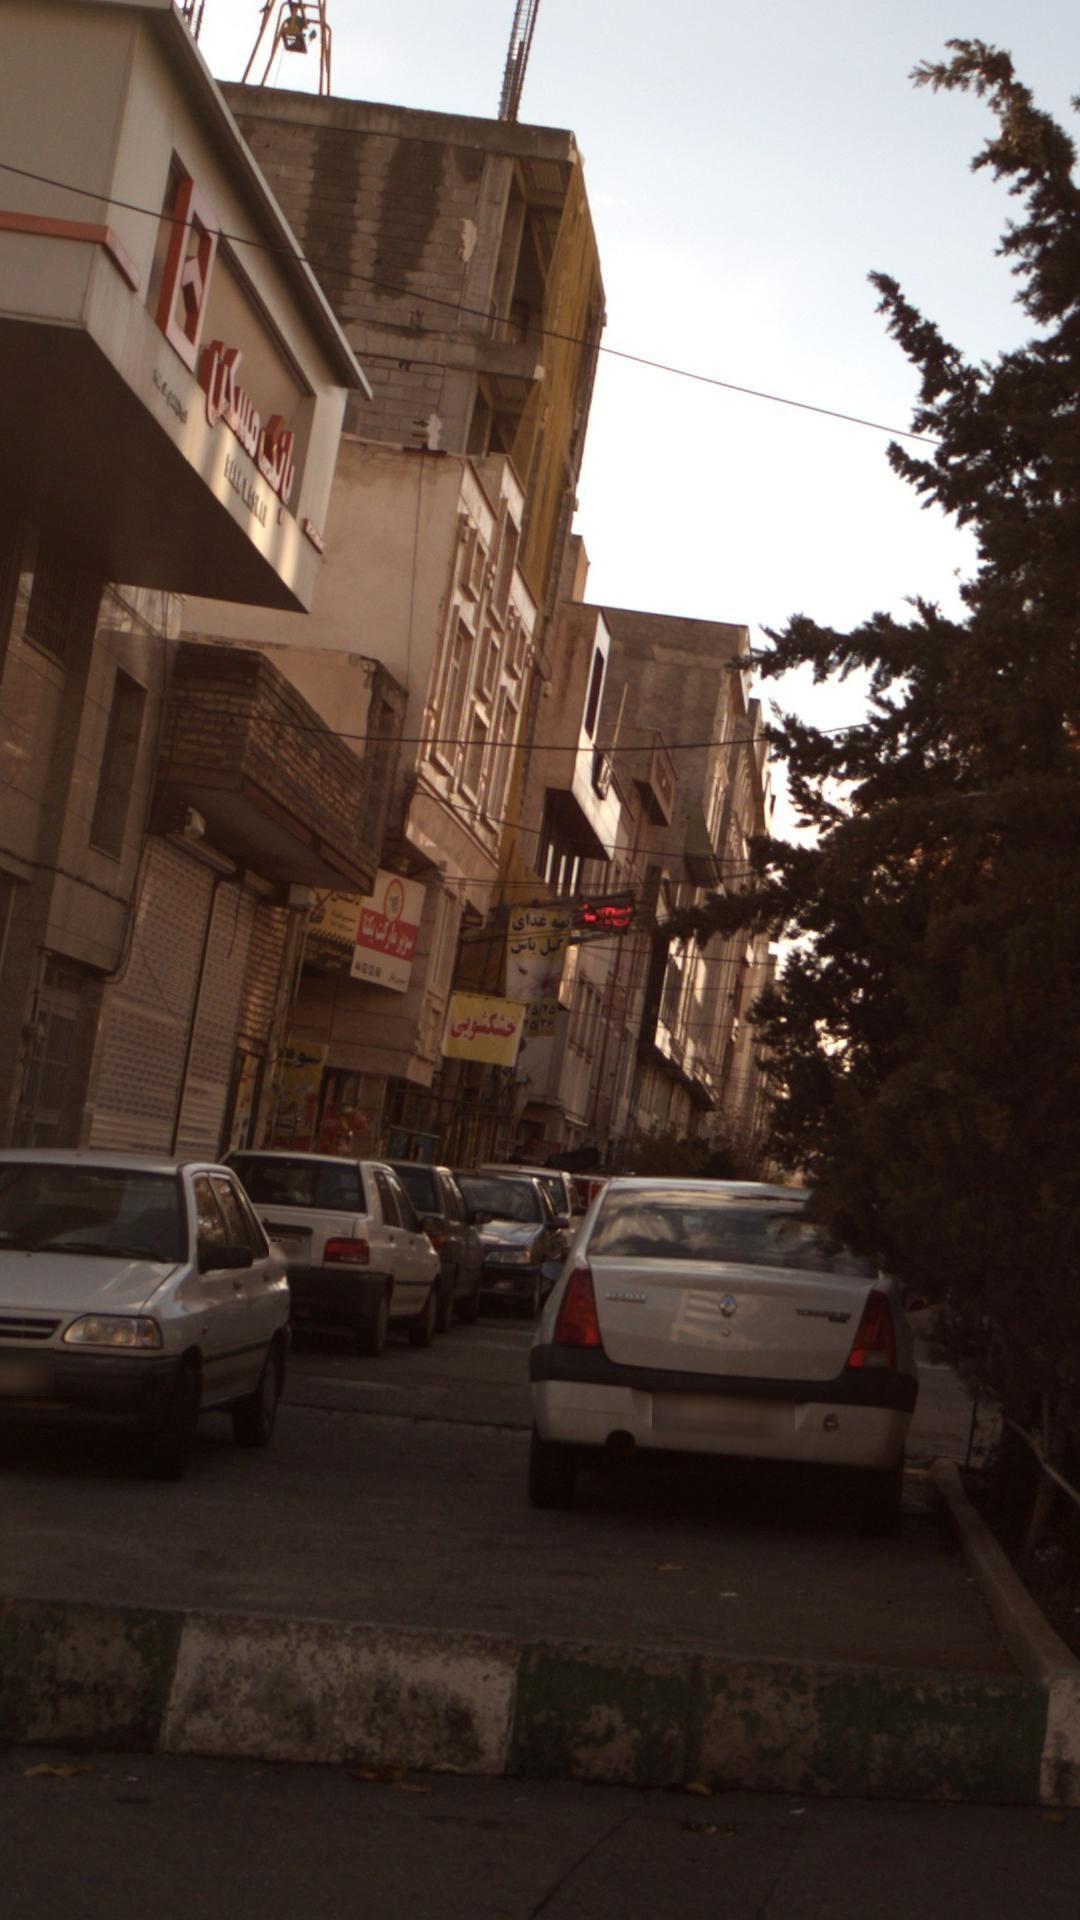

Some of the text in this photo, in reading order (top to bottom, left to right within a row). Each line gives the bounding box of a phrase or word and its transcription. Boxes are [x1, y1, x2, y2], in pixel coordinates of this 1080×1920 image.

[202, 341, 261, 459] مسکن
[256, 415, 295, 505] بانک
[512, 914, 547, 931] غذای
